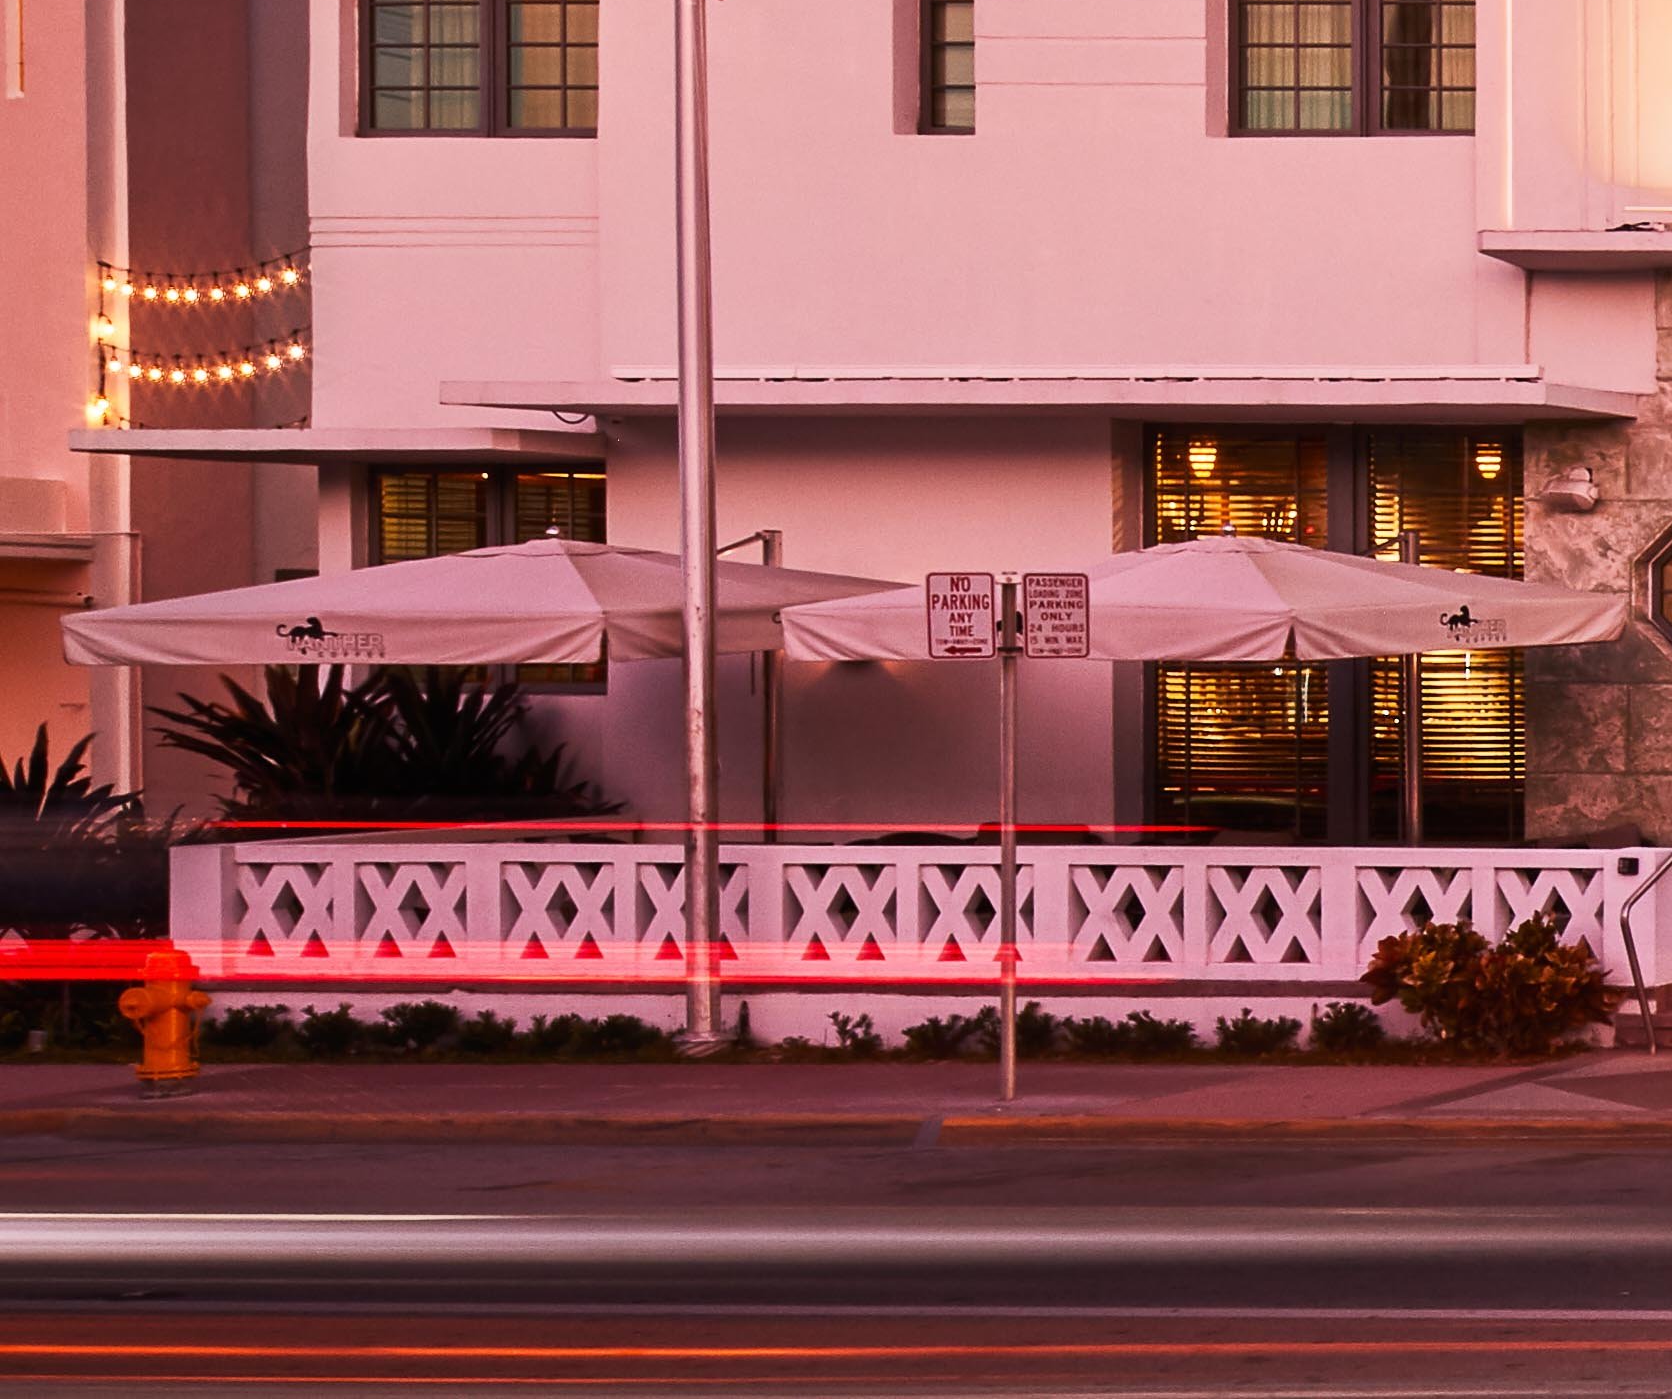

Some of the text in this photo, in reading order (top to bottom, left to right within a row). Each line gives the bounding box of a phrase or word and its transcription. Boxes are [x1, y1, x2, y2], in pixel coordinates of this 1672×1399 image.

[950, 577, 971, 592] NO
[1028, 578, 1083, 588] PASSENGER
[932, 594, 990, 610] PARKING
[1029, 600, 1084, 610] PARKING
[949, 612, 974, 623] ANY
[1041, 612, 1073, 621] ONLY
[949, 625, 974, 637] TIME
